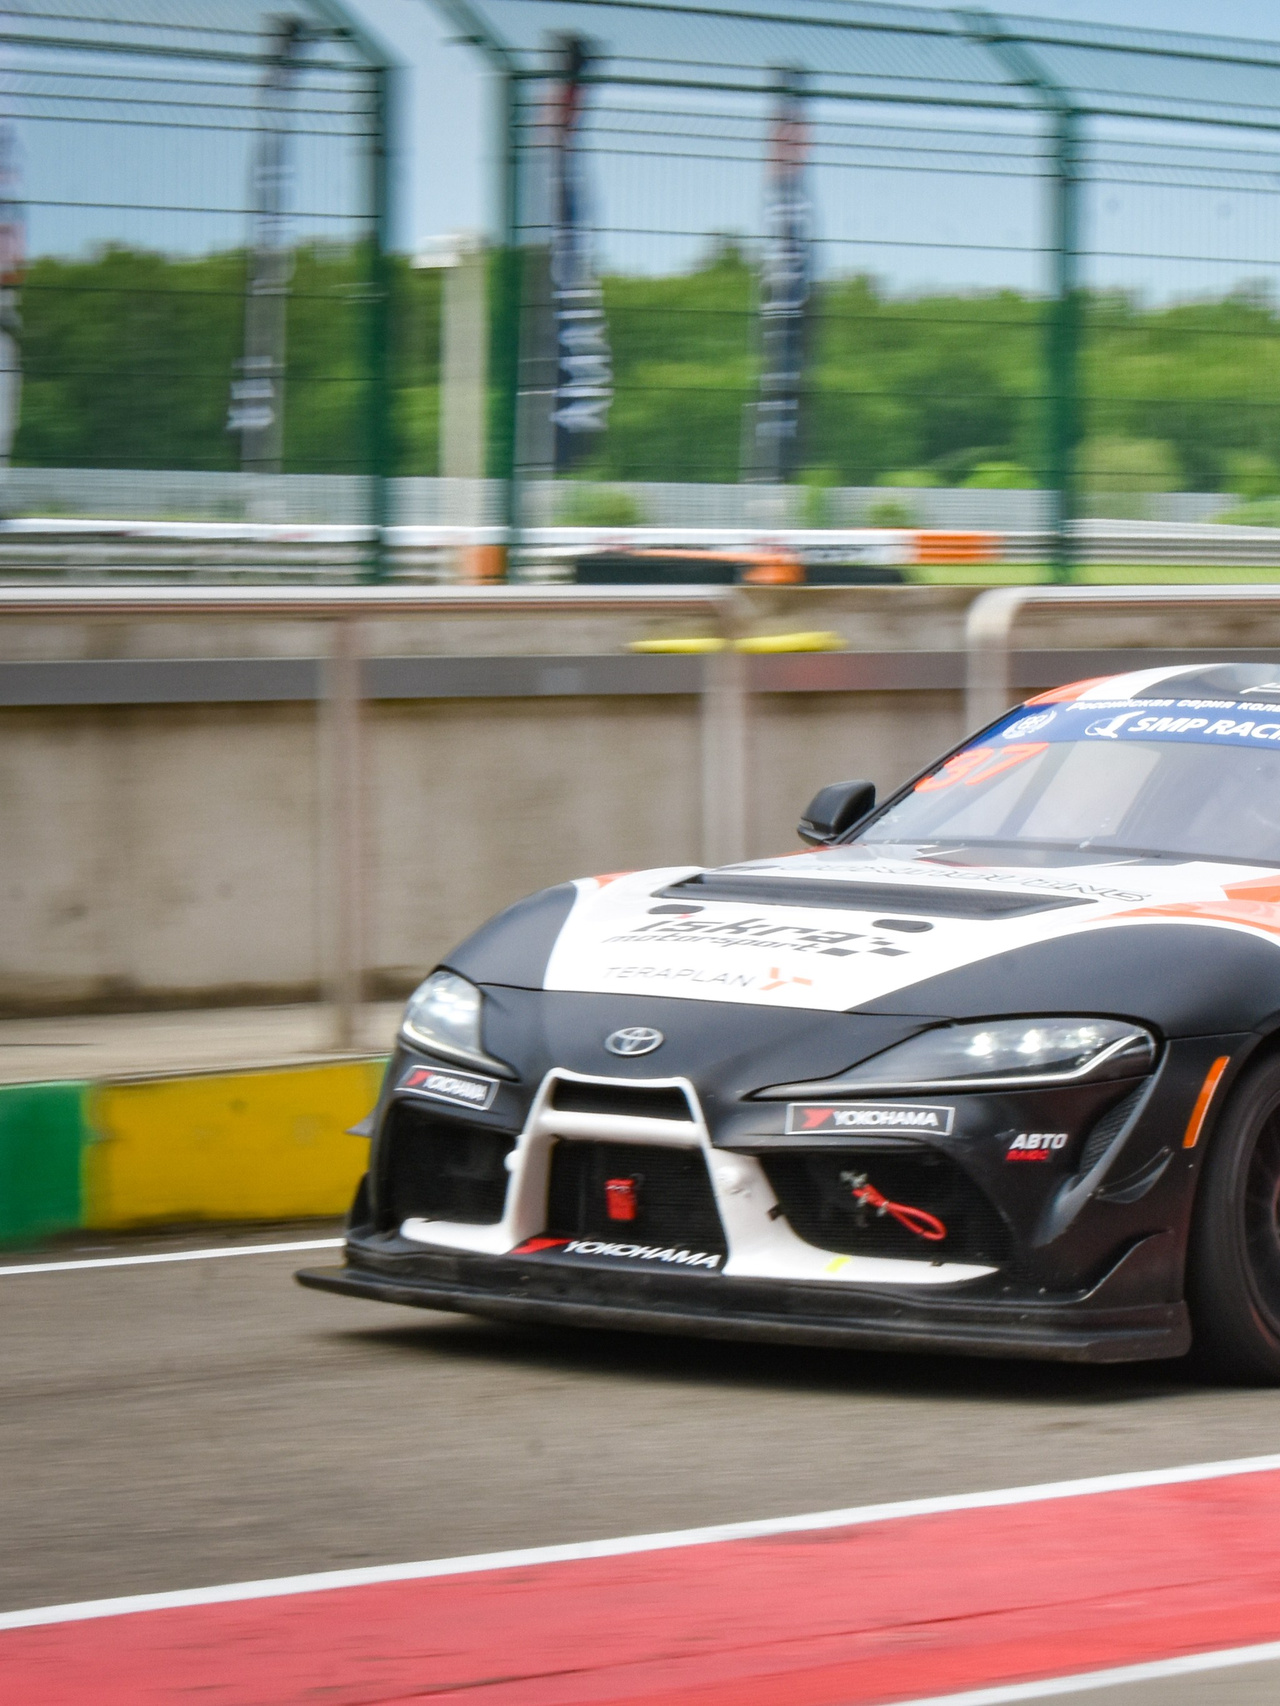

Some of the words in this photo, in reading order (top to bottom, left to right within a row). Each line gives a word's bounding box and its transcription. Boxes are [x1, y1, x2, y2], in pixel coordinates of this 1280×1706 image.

[1128, 717, 1209, 733] SMP
[914, 741, 1050, 793] 37
[602, 931, 821, 952] motorsport
[603, 966, 756, 987] TERAPLAN
[833, 1110, 939, 1127] YOKOHAMA
[1009, 1133, 1068, 1150] АВТО
[562, 1240, 722, 1269] YOKOHAMA
